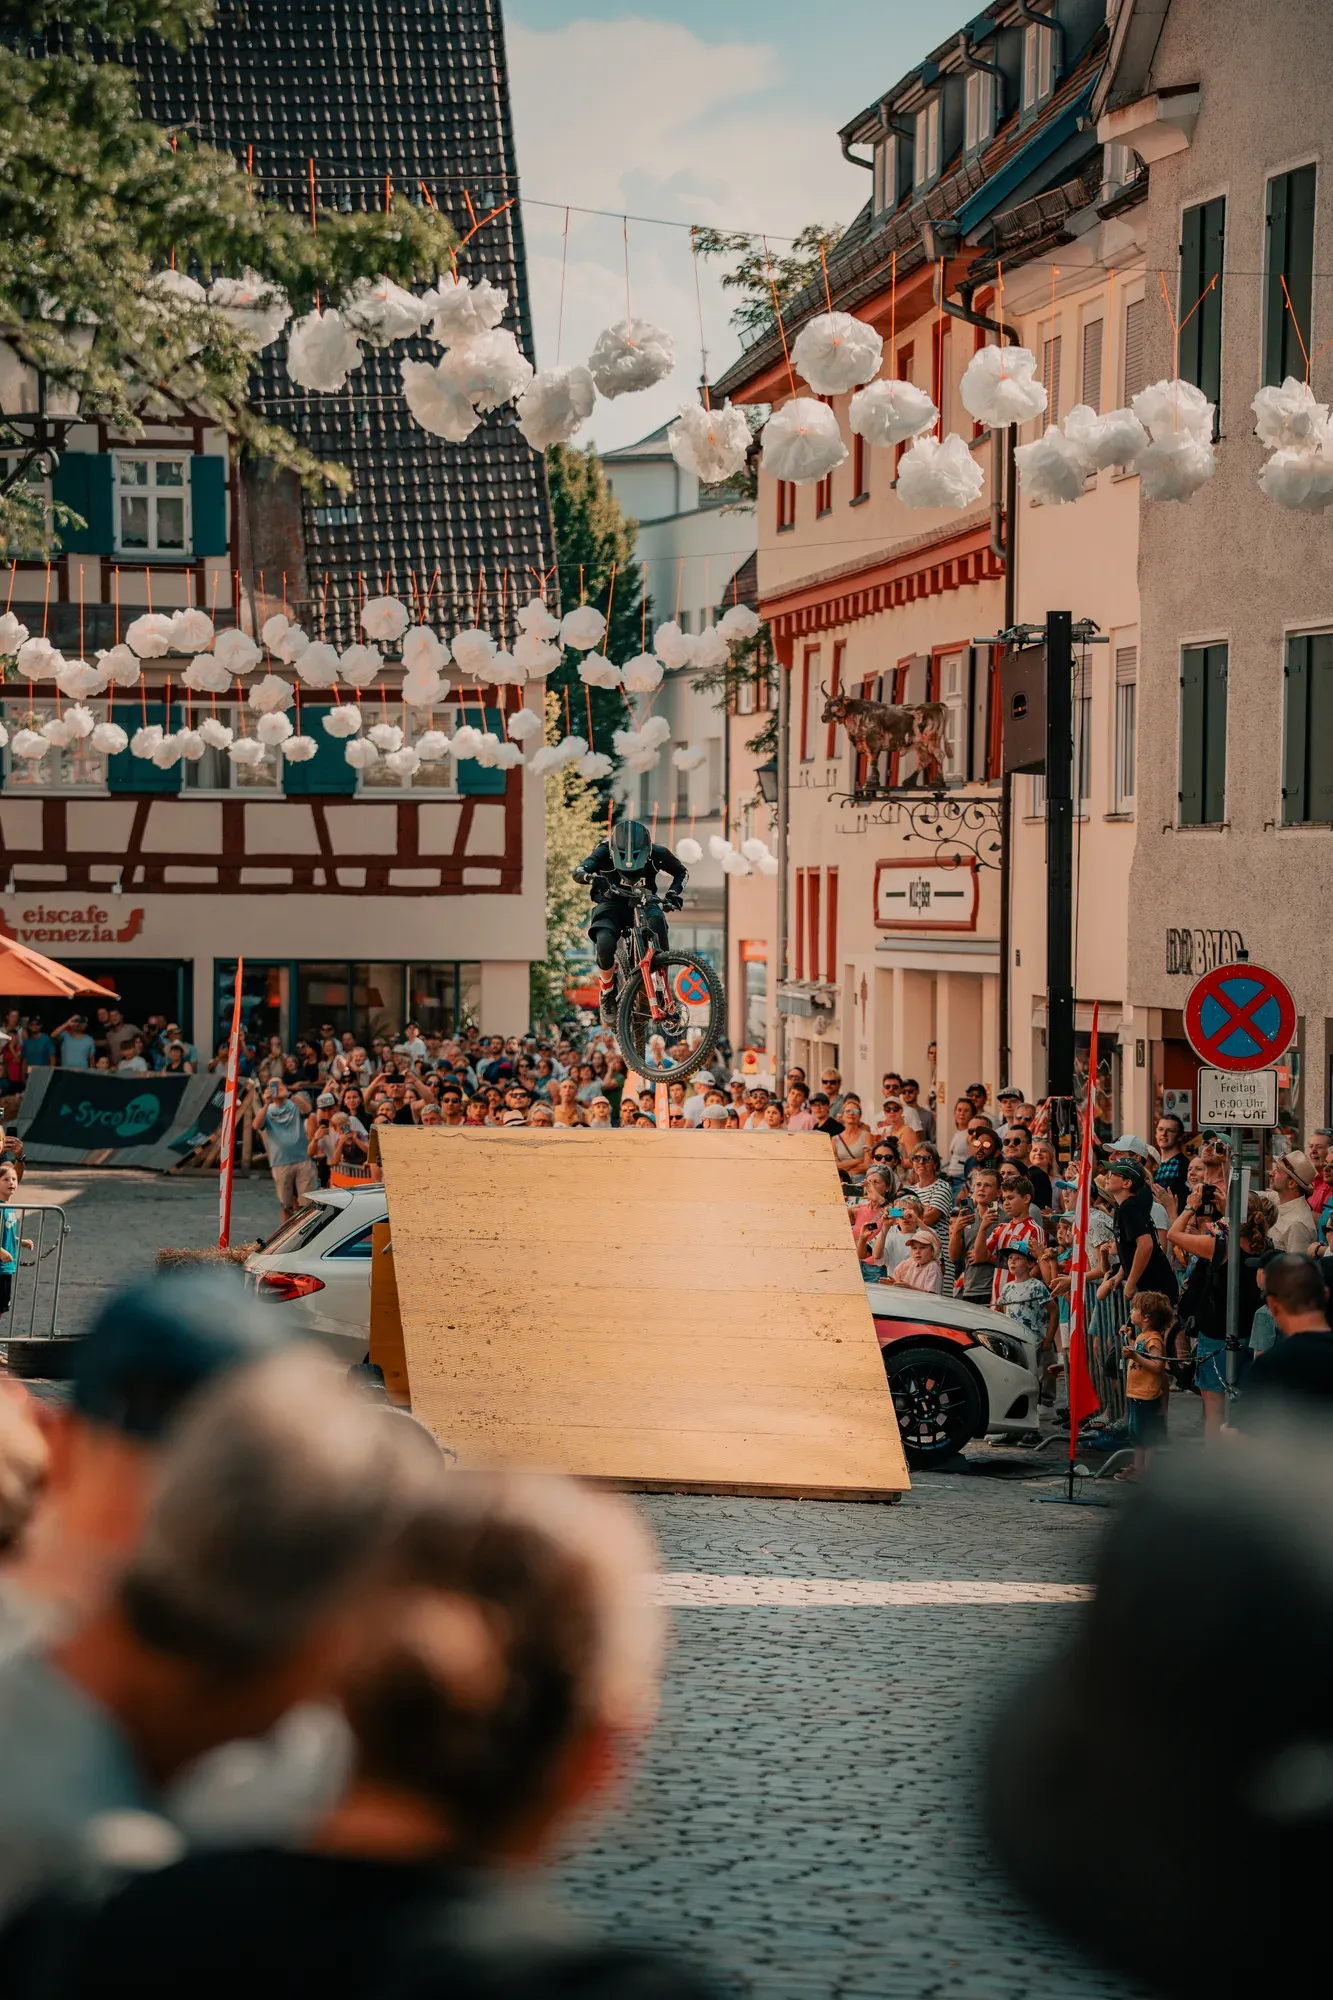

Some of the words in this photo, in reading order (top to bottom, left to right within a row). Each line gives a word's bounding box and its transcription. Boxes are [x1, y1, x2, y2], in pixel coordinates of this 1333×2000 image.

[22, 904, 109, 924] eiscafe
[20, 925, 117, 942] venezia
[1221, 1083, 1256, 1095] Freitag
[1214, 1099, 1243, 1109] 16:00
[1246, 1098, 1265, 1108] Uhr
[75, 1100, 156, 1128] SycoTec
